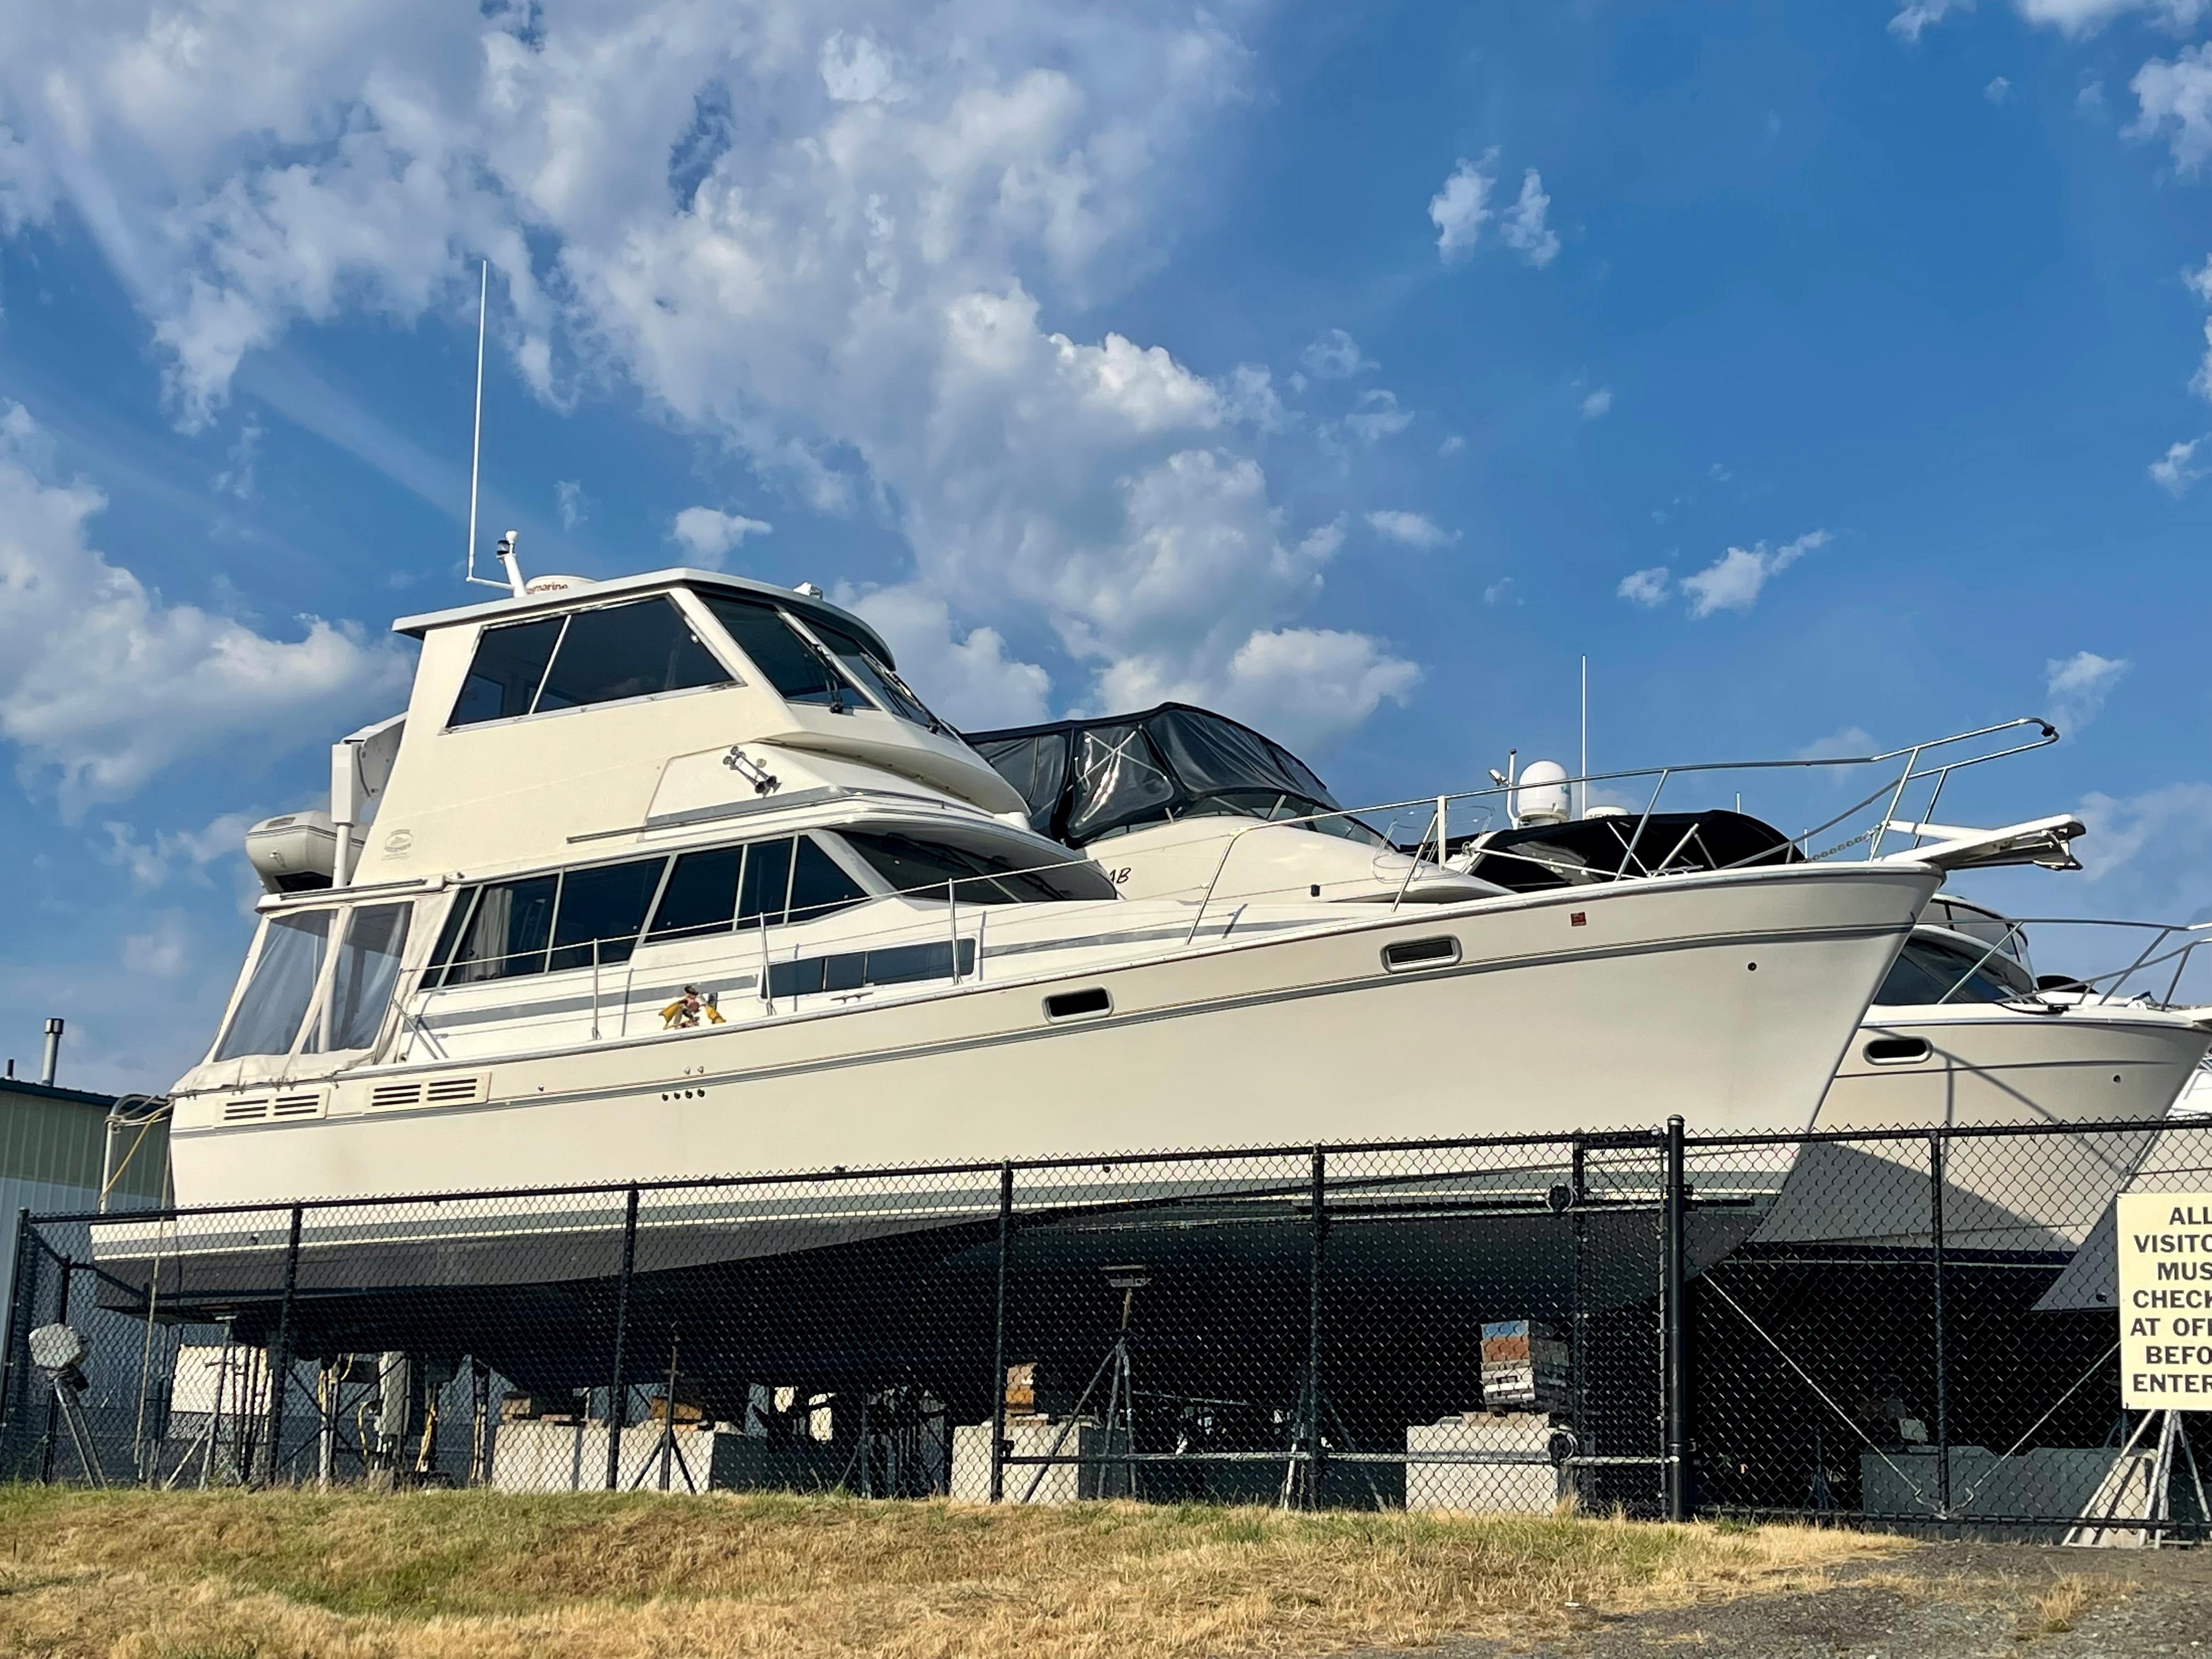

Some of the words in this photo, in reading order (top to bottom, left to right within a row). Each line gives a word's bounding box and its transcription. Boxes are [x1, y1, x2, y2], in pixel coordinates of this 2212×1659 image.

[2169, 1206, 2212, 1225] ALL
[2130, 1318, 2160, 1336] AT
[2146, 1346, 2212, 1364] BEFO
